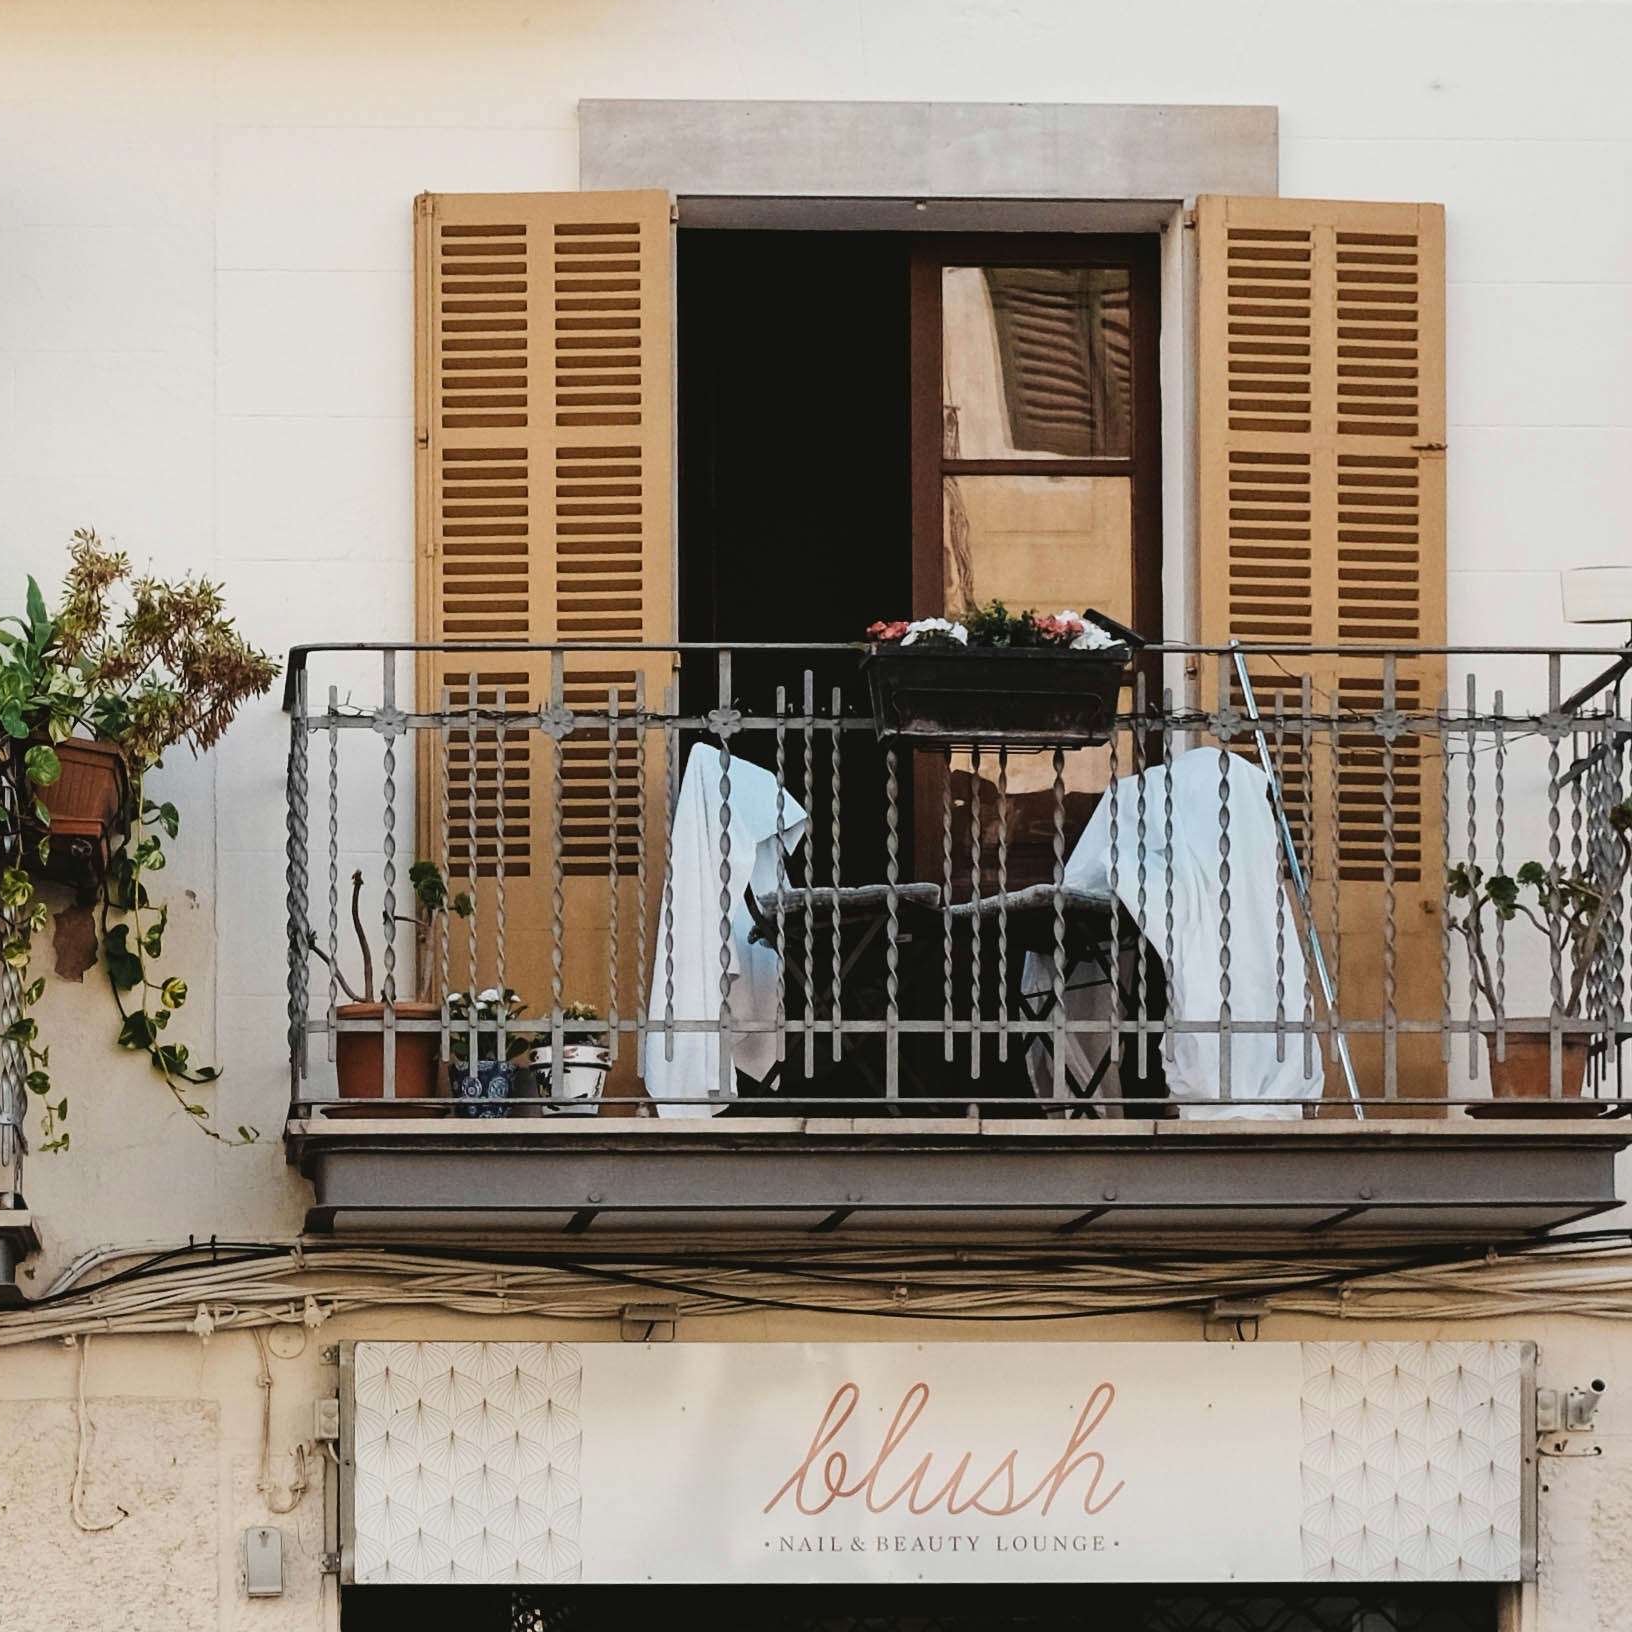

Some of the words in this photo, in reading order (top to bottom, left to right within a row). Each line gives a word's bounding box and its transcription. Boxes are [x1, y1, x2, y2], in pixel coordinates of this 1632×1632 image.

[763, 1382, 1125, 1516] blush
[779, 1535, 842, 1552] NAIL
[850, 1535, 865, 1552] &
[877, 1535, 980, 1552] BEAUTY
[997, 1535, 1105, 1552] LOUNGE
